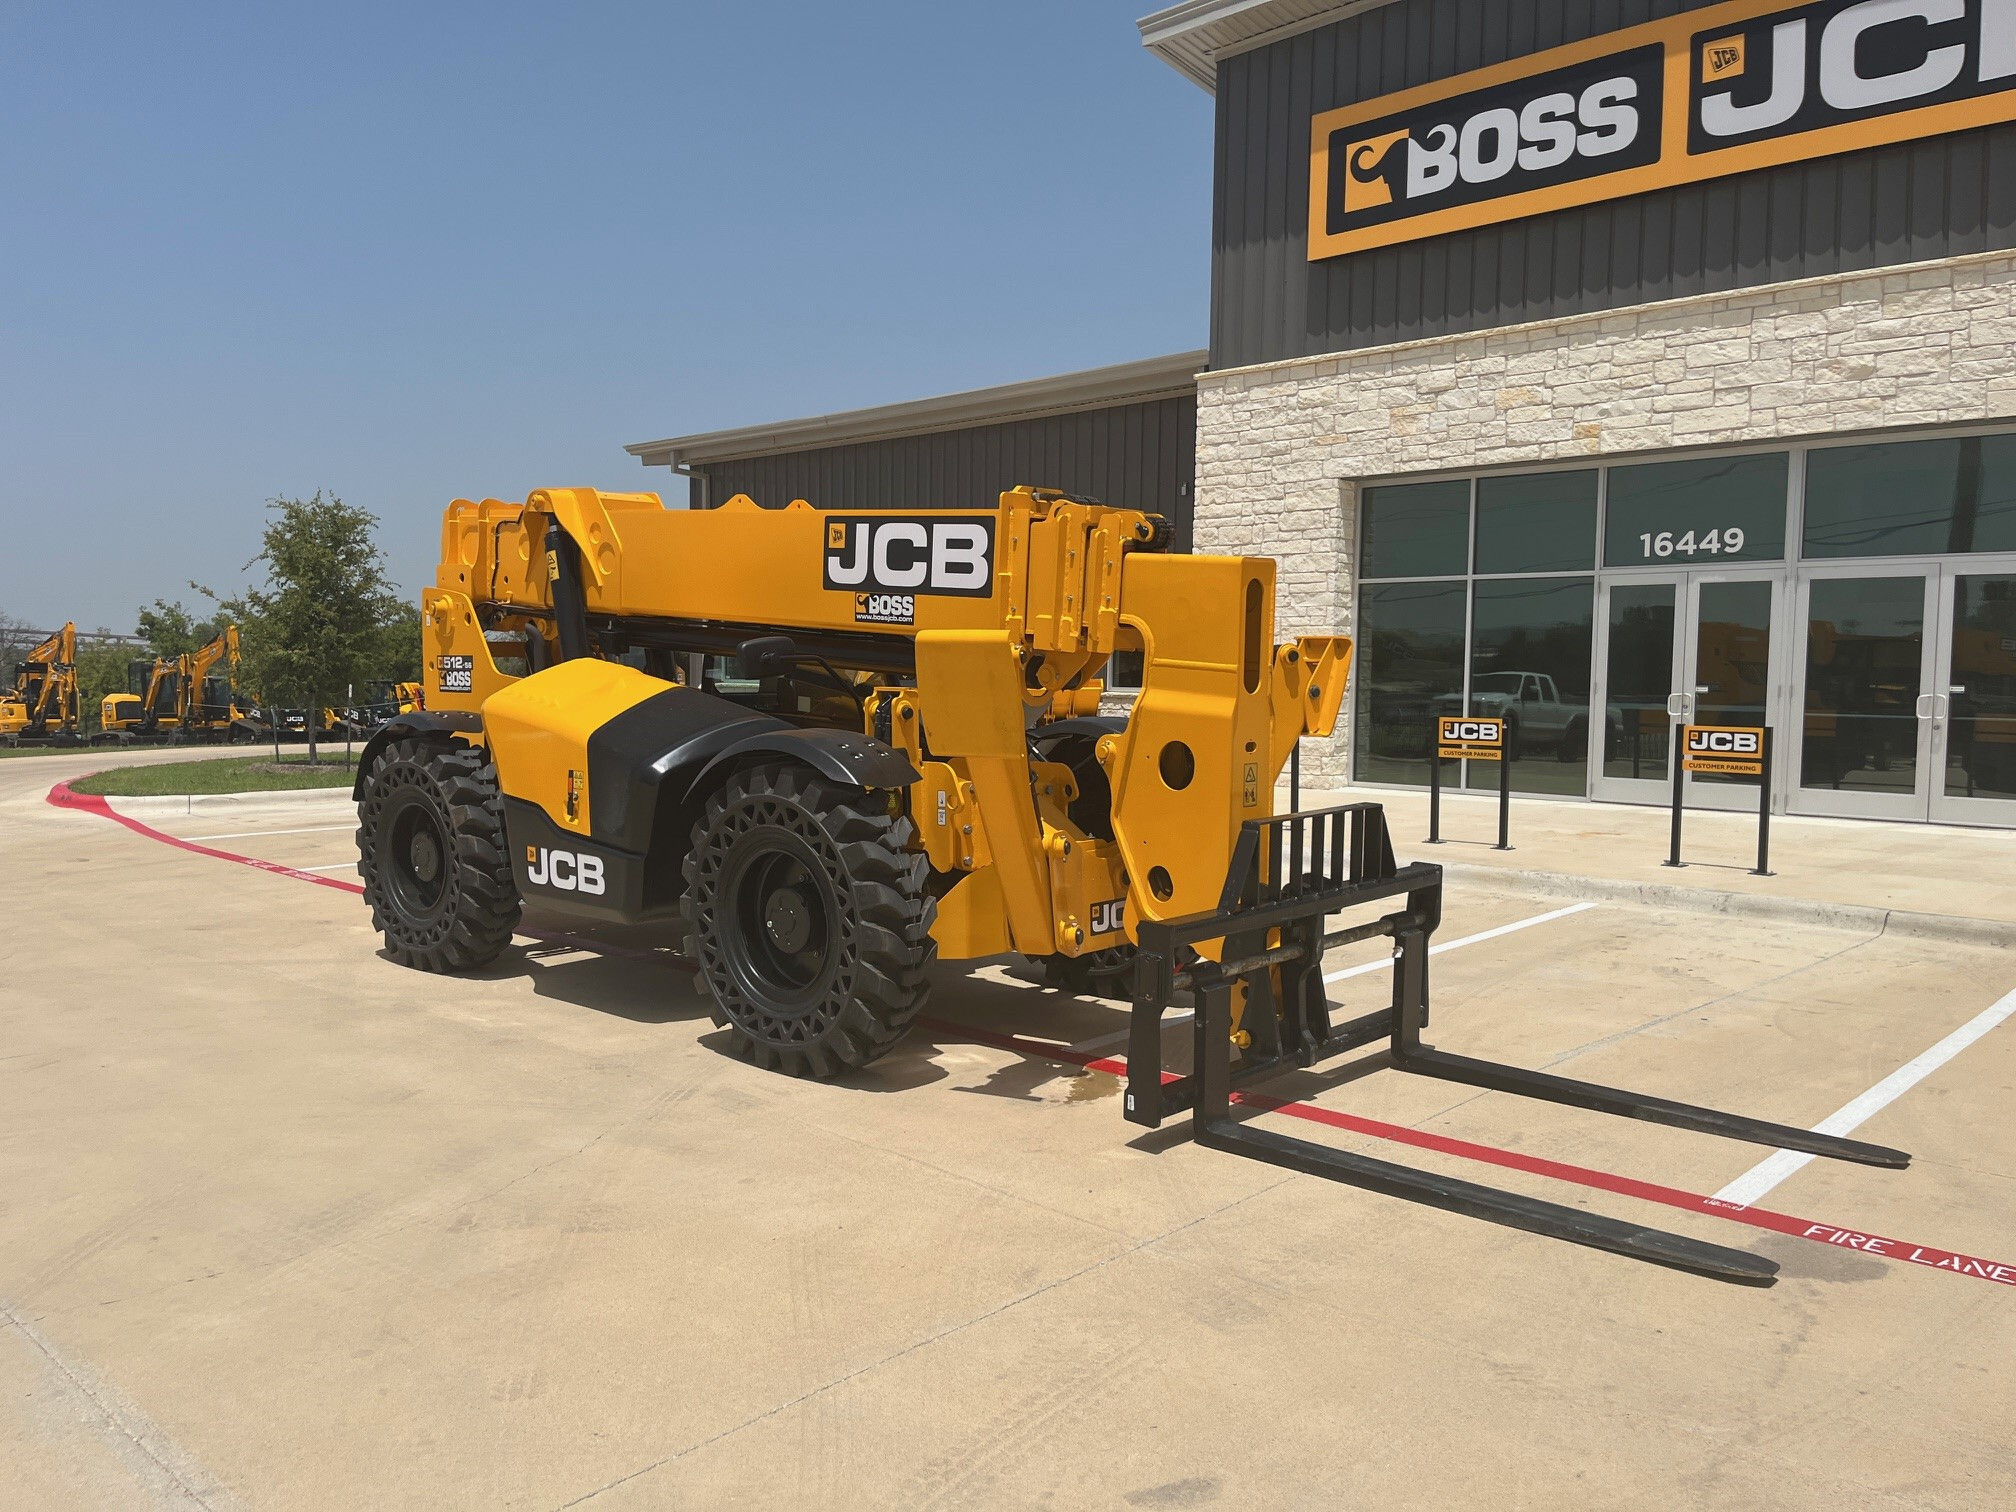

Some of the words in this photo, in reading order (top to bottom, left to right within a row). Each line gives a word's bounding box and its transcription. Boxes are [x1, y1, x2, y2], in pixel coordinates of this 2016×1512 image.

[1700, 0, 2016, 137] JC
[1713, 49, 1738, 70] JCB
[1406, 75, 1639, 199] BOSS
[1640, 527, 1745, 558] 16449
[827, 522, 989, 590] JCB
[856, 613, 913, 623] www.bossjcb.com
[868, 594, 914, 616] BOSS
[446, 671, 471, 687] BOSS
[1444, 722, 1498, 740] JCB
[1690, 732, 1757, 752] JCB
[1688, 762, 1725, 770] CUSTOMER
[1726, 764, 1757, 772] PARKING
[527, 847, 606, 896] JCB
[1092, 900, 1126, 933] JC
[1802, 1224, 1896, 1255] FIRE
[1908, 1248, 2016, 1285] LANE
